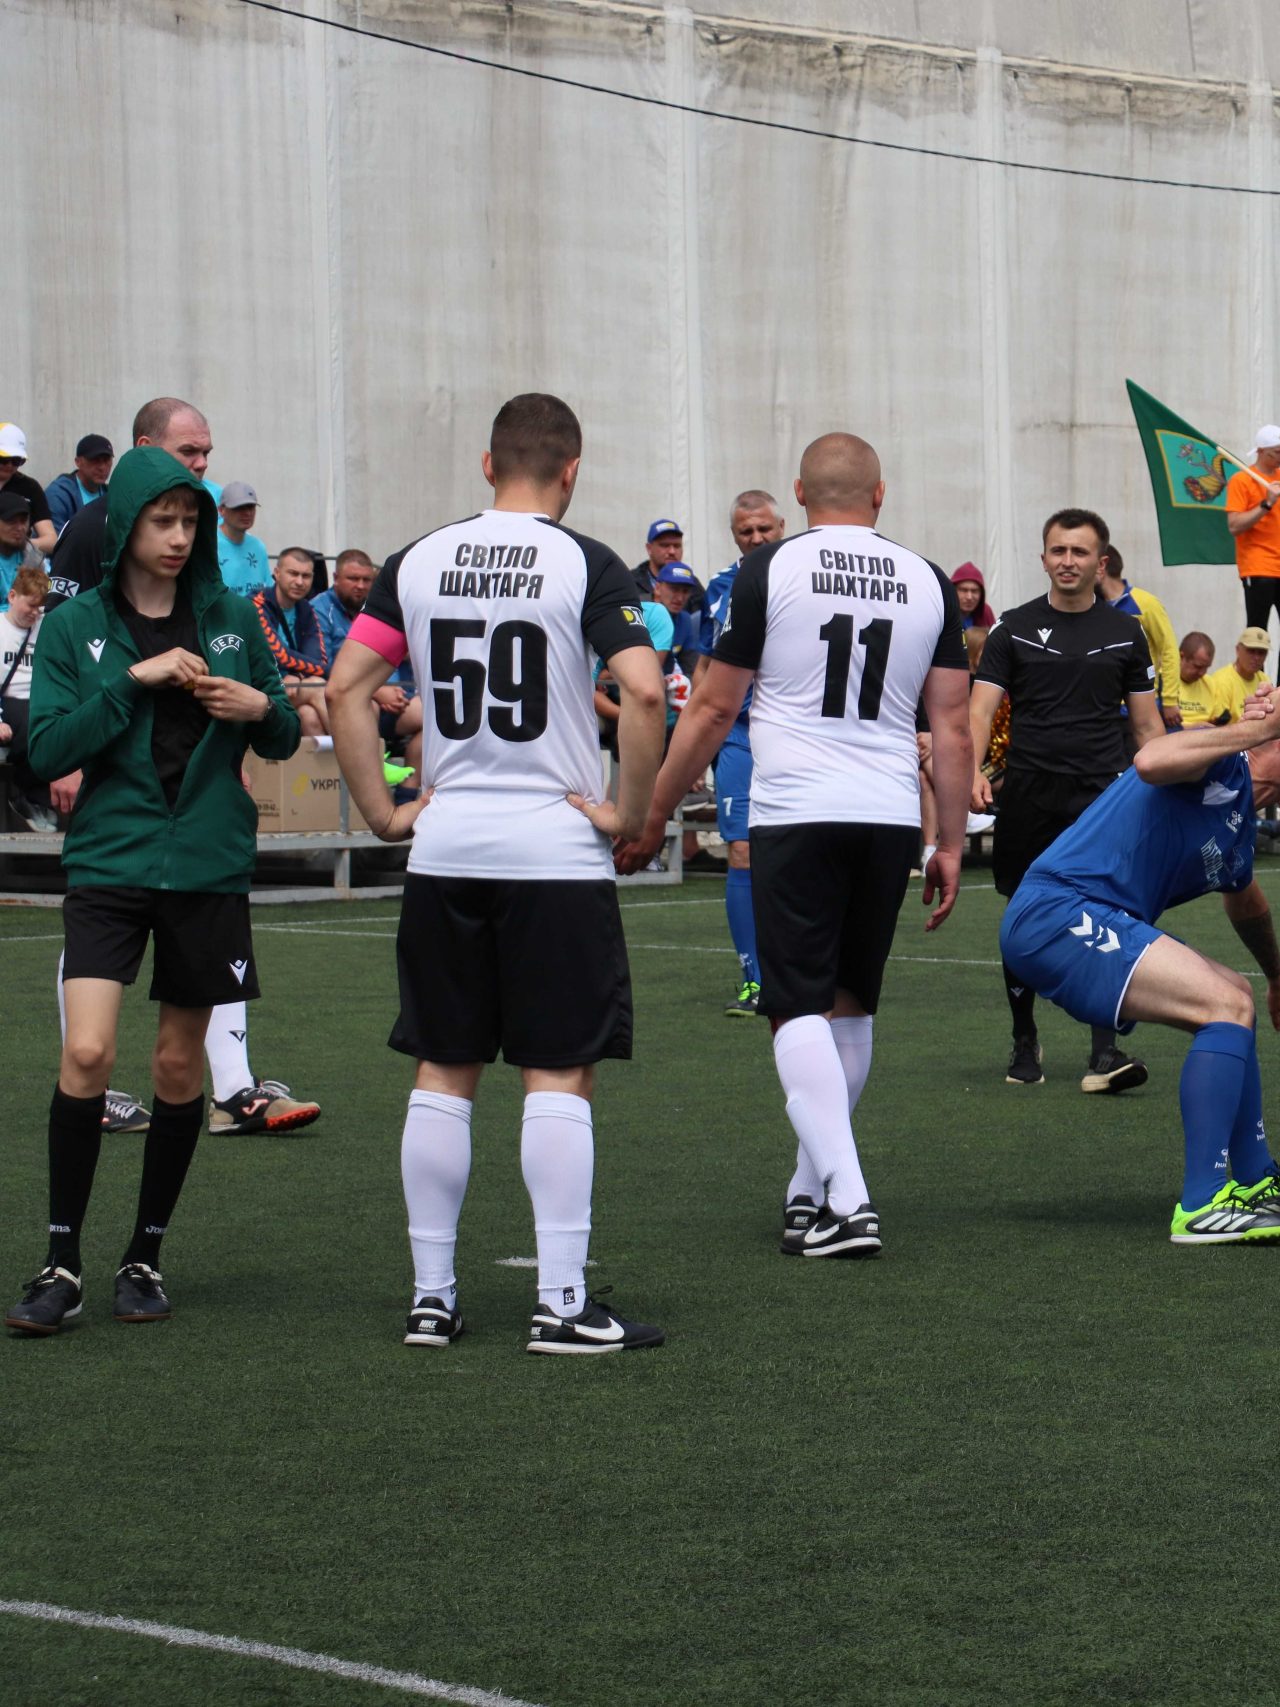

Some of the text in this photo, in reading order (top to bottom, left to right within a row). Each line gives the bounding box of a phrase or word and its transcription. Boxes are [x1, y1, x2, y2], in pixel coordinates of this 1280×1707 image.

[455, 543, 539, 569] СВІТЛО
[819, 549, 896, 577] СВІТЛО
[439, 570, 544, 599] ШАХТАРЯ
[811, 572, 908, 605] ШАХТАРЯ
[212, 636, 240, 652] UEFA
[430, 618, 548, 742] 59
[819, 613, 894, 721] 11
[722, 796, 733, 817] 7
[794, 1215, 810, 1224] NIKE
[419, 1319, 438, 1328] NIKE
